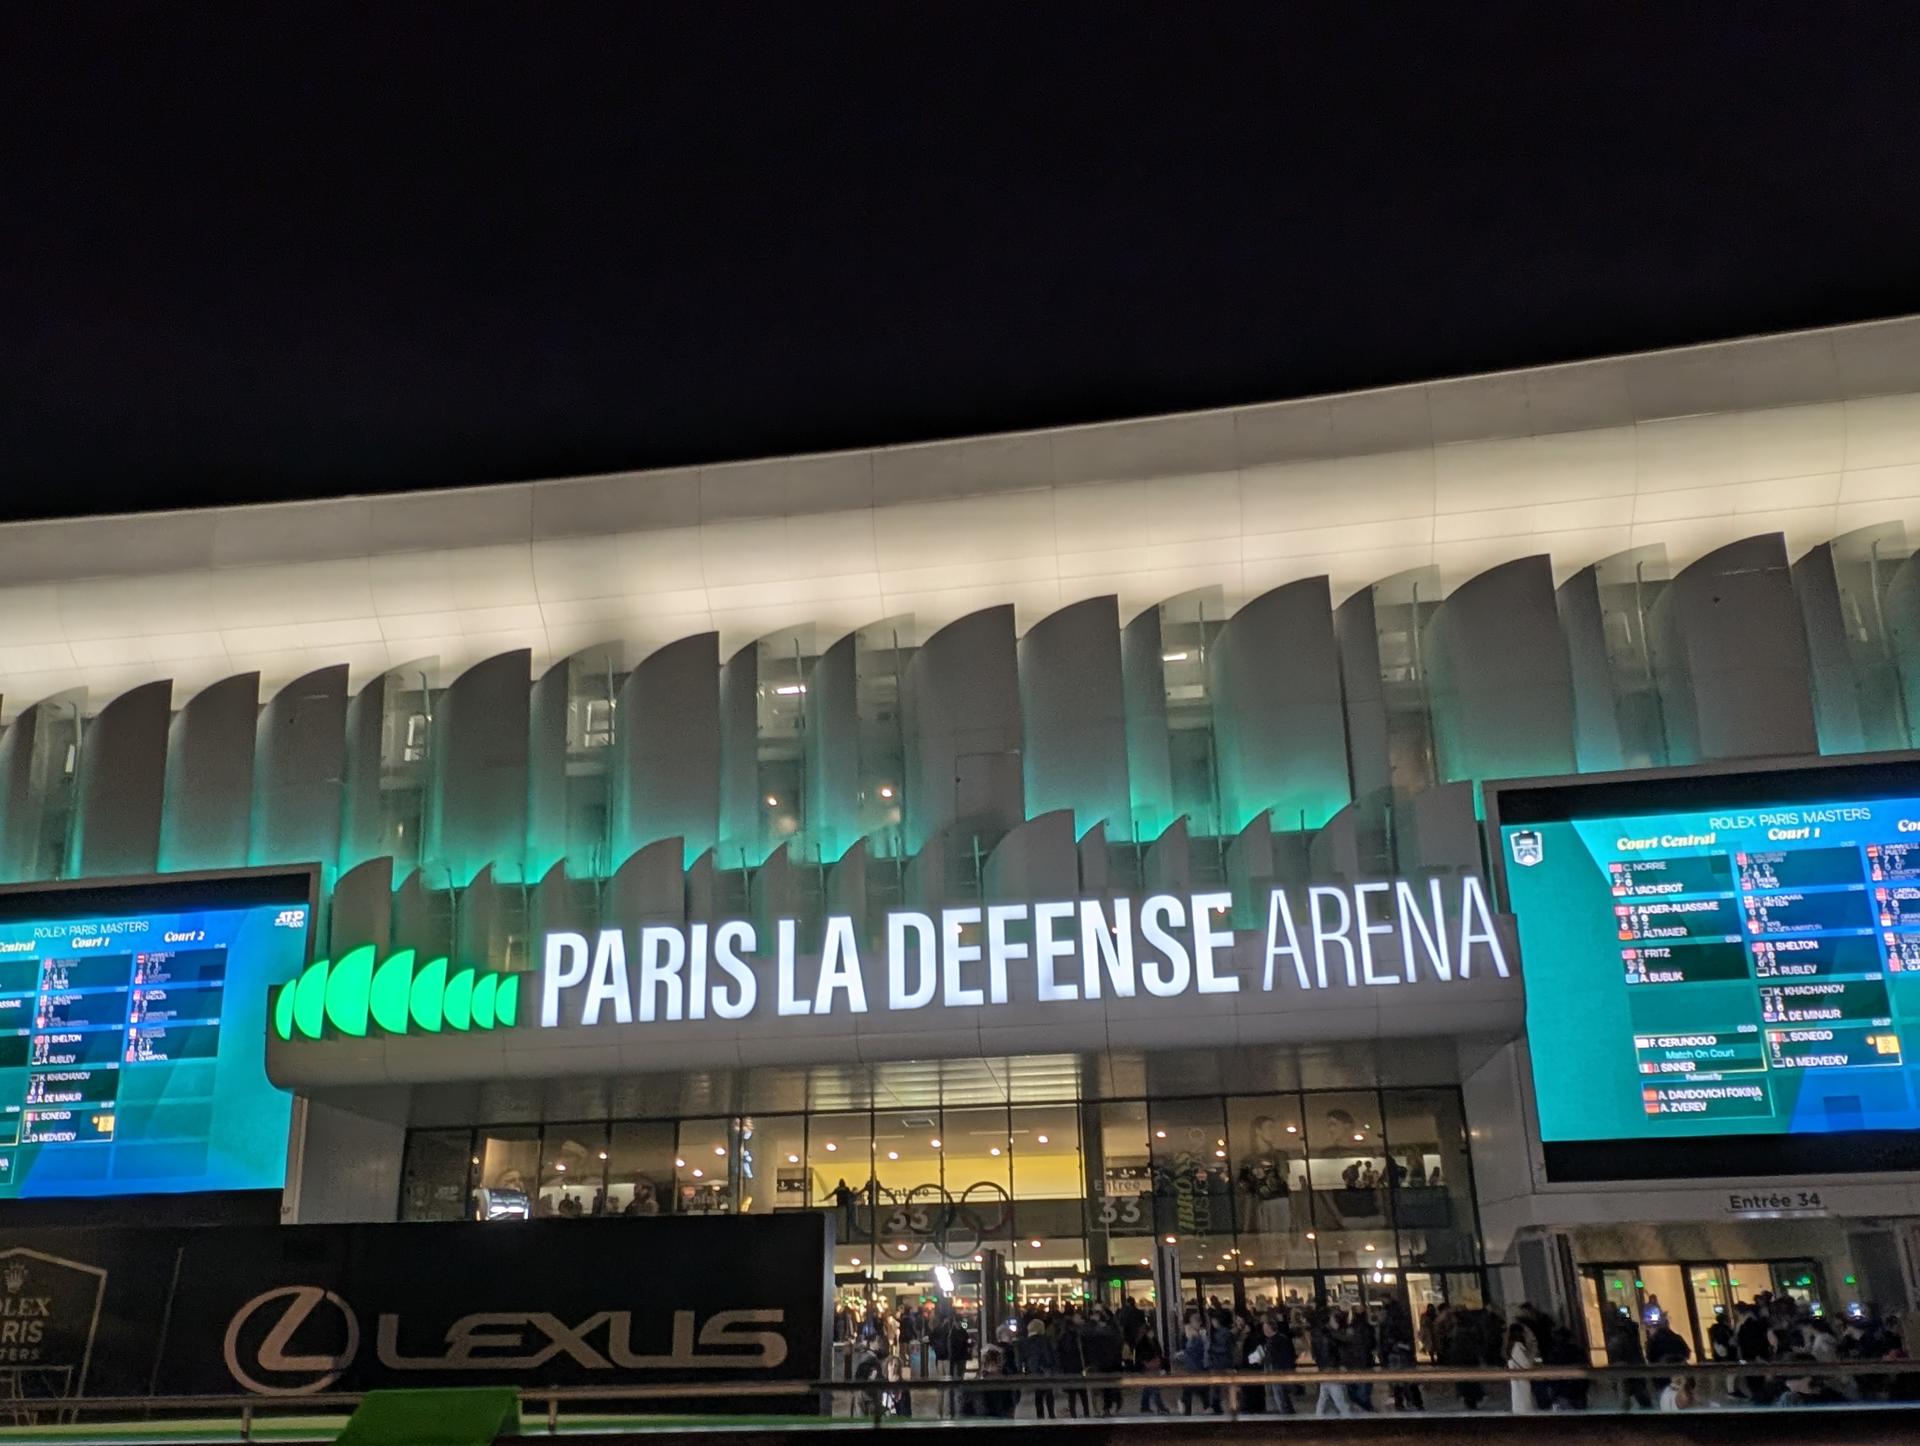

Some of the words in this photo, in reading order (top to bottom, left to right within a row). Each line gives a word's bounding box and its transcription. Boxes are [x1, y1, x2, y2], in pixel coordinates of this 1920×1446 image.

[1710, 816, 1756, 830] ROLEX
[1760, 812, 1799, 826] PARIS
[1803, 808, 1871, 823] MASTERS
[1768, 827, 1810, 840] Court
[1617, 837, 1658, 850] Court
[1661, 832, 1716, 847] Central
[1633, 862, 1666, 872] NORRIE
[1636, 883, 1684, 894] VACHEROT
[1638, 902, 1719, 914] AUGER-ALIASSIME
[275, 910, 305, 923] ATP
[34, 927, 67, 938] ROLEX
[69, 925, 97, 936] PARIS
[100, 921, 149, 934] MASTERS
[1643, 927, 1687, 938] ALTMAIER
[164, 931, 196, 943] Court
[72, 937, 102, 949] Court
[1776, 940, 1819, 950] SHELTON
[540, 920, 757, 1028] PARIS
[778, 916, 868, 1016] LA
[888, 892, 1240, 1011] DEFENSE
[1263, 877, 1510, 991] ARENA
[1645, 948, 1671, 958] FRITZ
[1781, 965, 1817, 975] RUBLEV
[1650, 972, 1684, 982] BUBLIK
[1784, 984, 1844, 995] KHACHANOV
[1788, 1012, 1802, 1021] DE
[1803, 1009, 1842, 1020] MINAUR
[51, 1035, 82, 1043] SHELTON
[1658, 1036, 1717, 1047] CERUNDOLO
[1790, 1031, 1833, 1041] SONEGO
[1665, 1050, 1694, 1060] Match
[1695, 1050, 1709, 1059] On
[1710, 1049, 1735, 1058] Court
[1795, 1055, 1848, 1066] MEDVEDEV
[1660, 1062, 1696, 1072] SINNER
[47, 1073, 90, 1081] KHACHANOV
[1668, 1089, 1725, 1100] DAVIDOVICH
[1726, 1087, 1762, 1098] FOKINA
[1670, 1102, 1707, 1112] ZVEREV
[41, 1112, 71, 1120] SONEGO
[39, 1133, 76, 1142] MEDVEDEV
[1729, 1193, 1791, 1209] Entrée
[1798, 1192, 1821, 1207] 34
[1098, 1197, 1141, 1223] 33
[0, 1298, 51, 1317] LEX
[377, 1309, 788, 1369] LEXUS
